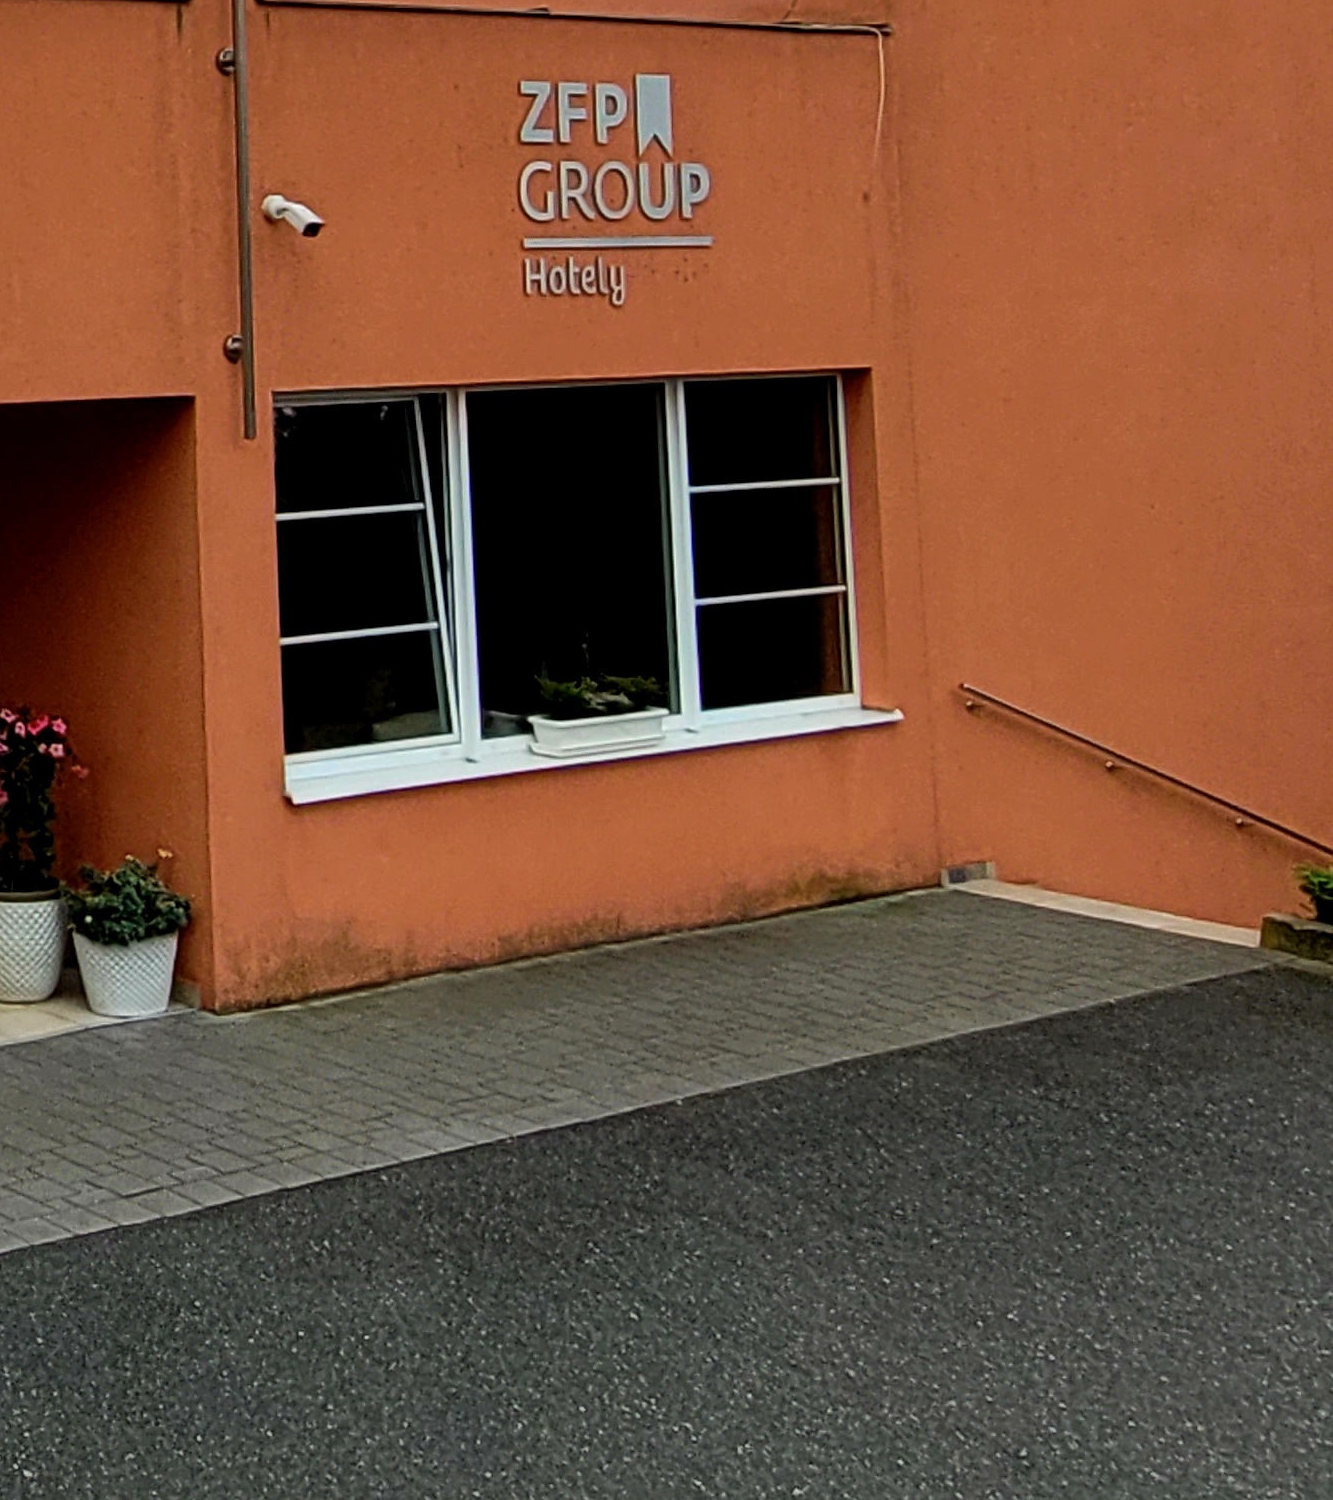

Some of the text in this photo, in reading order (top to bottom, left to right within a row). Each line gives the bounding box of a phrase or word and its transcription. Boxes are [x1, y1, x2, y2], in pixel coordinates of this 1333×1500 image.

[519, 80, 629, 144] ZFP
[519, 160, 711, 222] GROUP
[523, 255, 626, 307] Hotely
